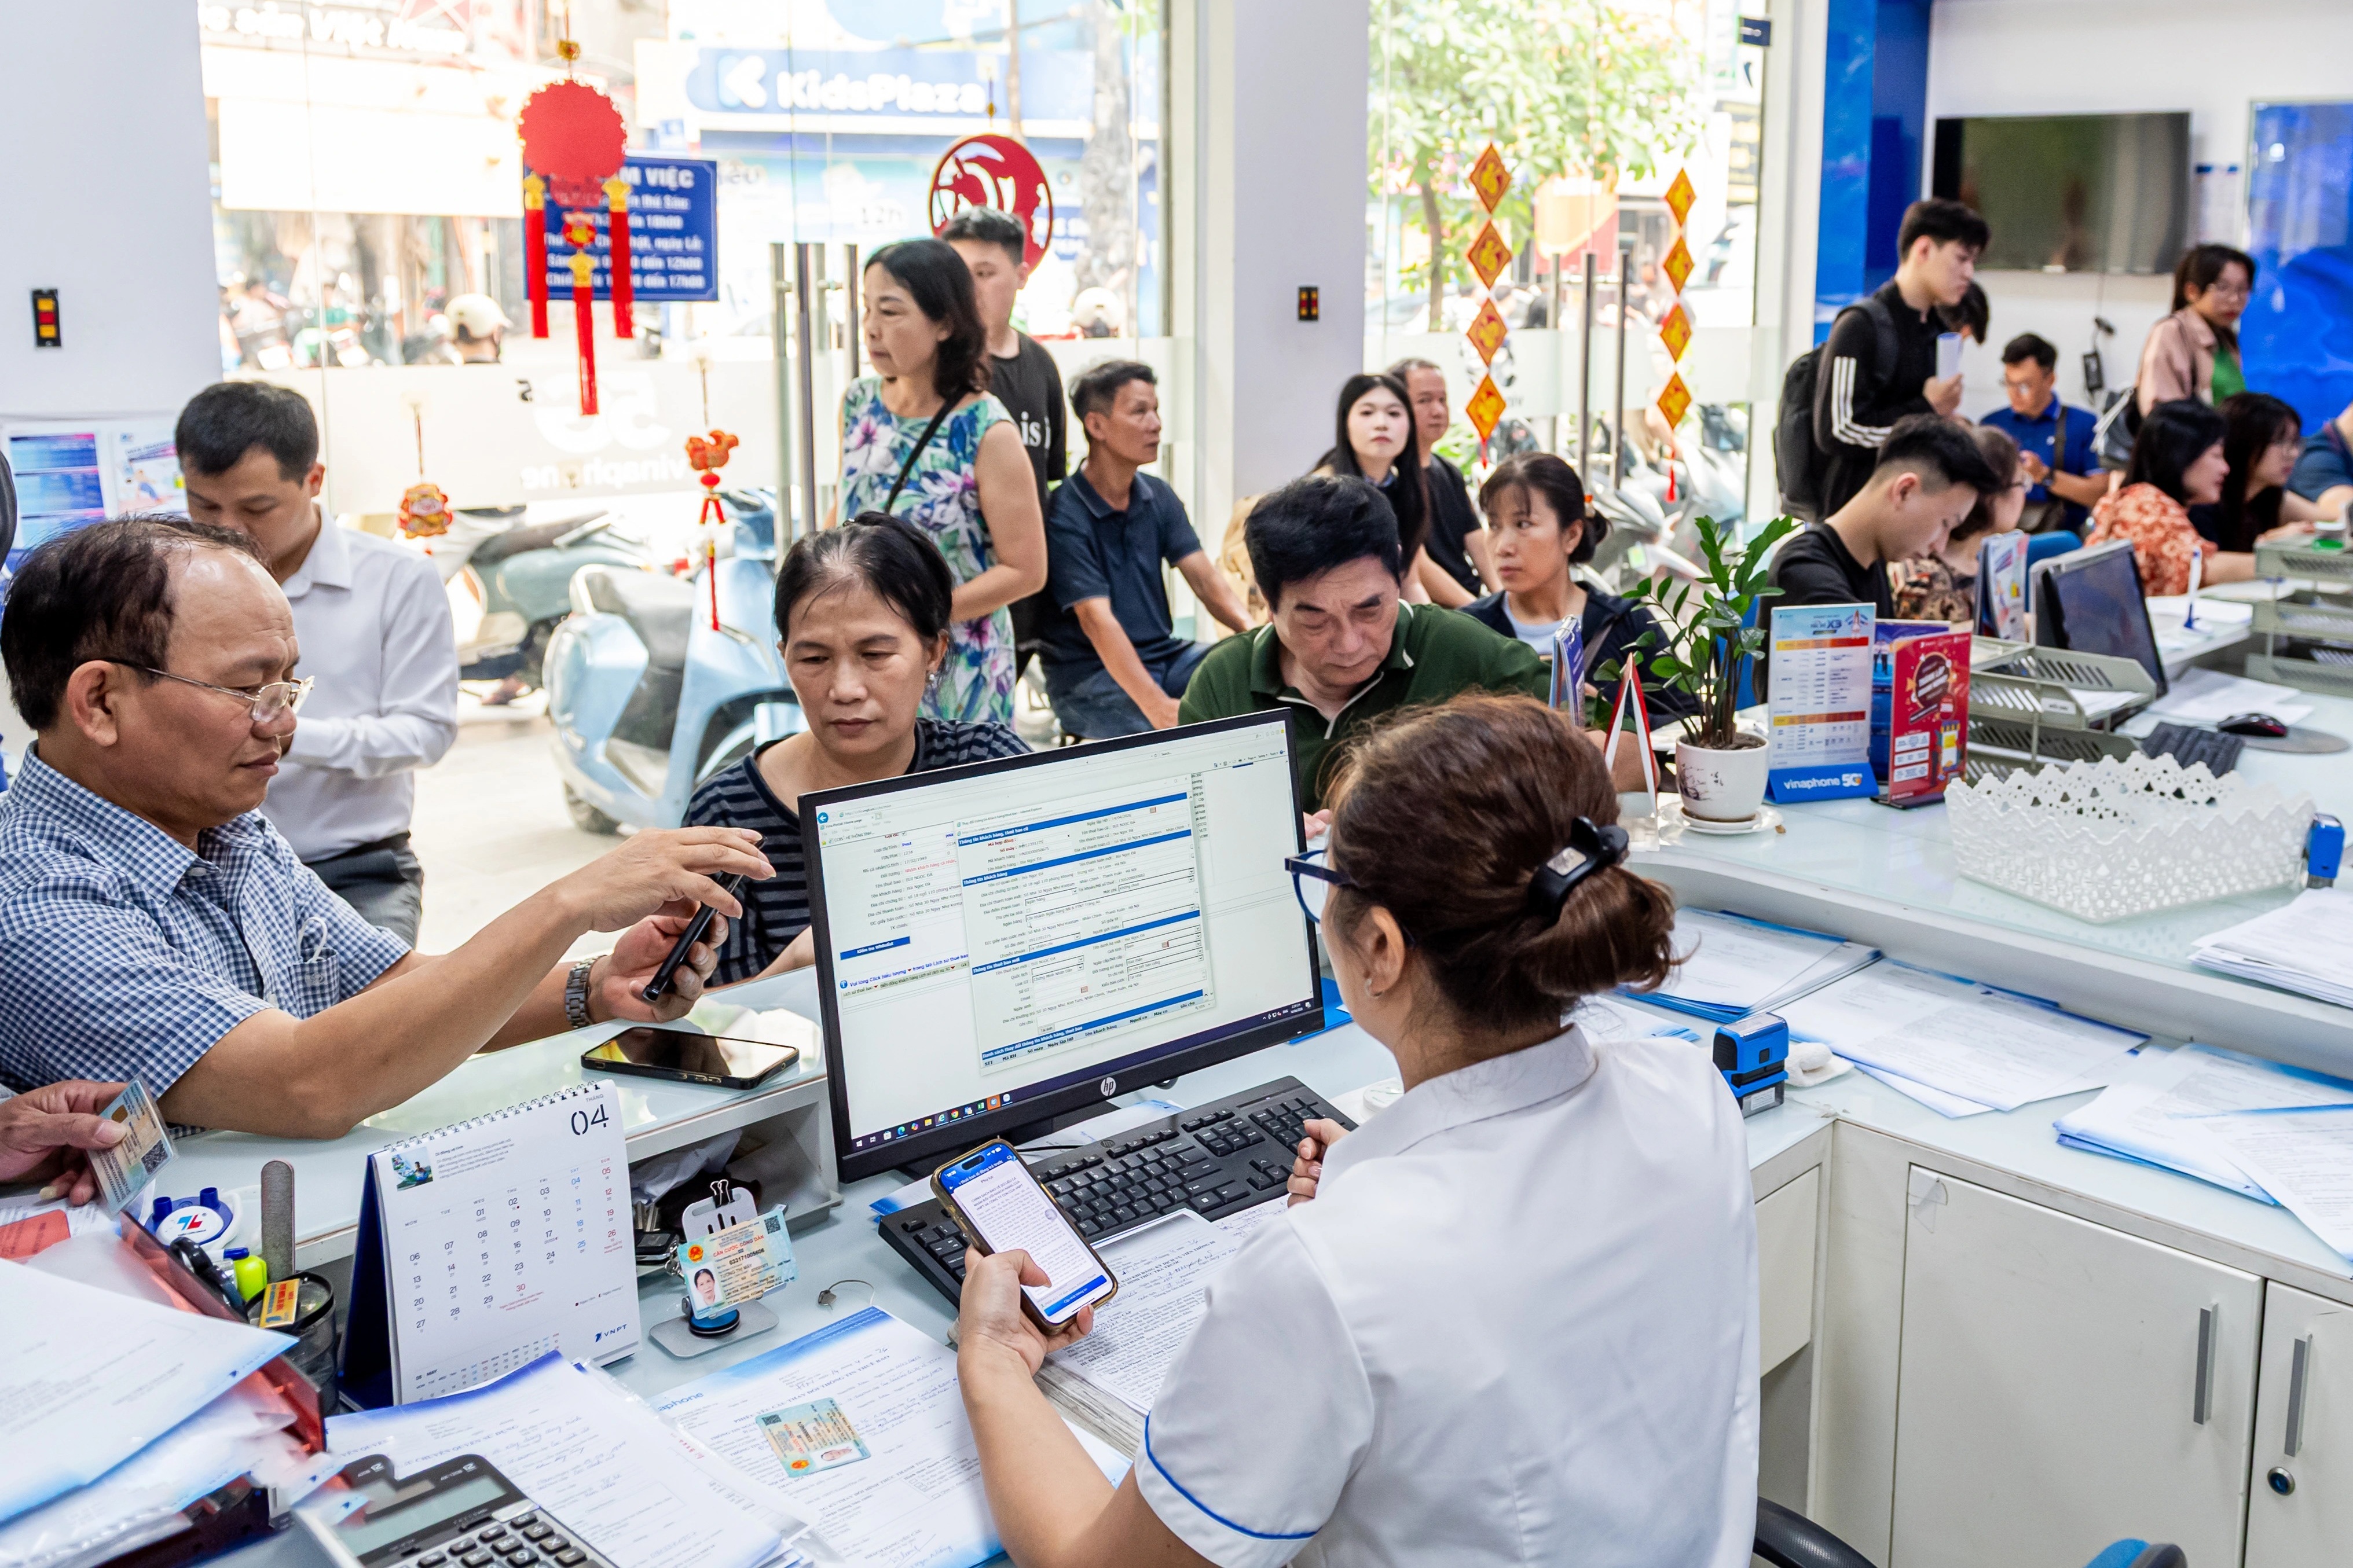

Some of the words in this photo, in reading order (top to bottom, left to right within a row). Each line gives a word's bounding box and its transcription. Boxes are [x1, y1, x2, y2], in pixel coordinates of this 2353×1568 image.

[776, 68, 985, 113] KidsPlaza
[644, 166, 695, 191] VIỆC
[1783, 777, 1840, 789] vinaphone
[1103, 1078, 1113, 1095] hp
[571, 1104, 609, 1135] 04
[476, 1208, 484, 1216] 01
[508, 1197, 518, 1206] 02
[540, 1187, 549, 1195] 03
[571, 1177, 580, 1185] 04
[602, 1166, 611, 1174] 05
[409, 1252, 420, 1261] 06
[444, 1240, 454, 1250] 07
[477, 1230, 488, 1239] 08
[510, 1219, 520, 1227] 09
[447, 1263, 455, 1272] 14
[481, 1251, 488, 1259] 15
[513, 1240, 521, 1248] 16
[545, 1229, 552, 1237] 17
[739, 1238, 753, 1247] CÔNG
[413, 1297, 424, 1306] 20
[449, 1286, 457, 1294] 21
[482, 1273, 491, 1282] 22
[514, 1262, 523, 1270] 23
[546, 1251, 555, 1259] 24
[577, 1239, 586, 1248] 25
[607, 1229, 616, 1237] 26
[416, 1319, 426, 1328] 27
[450, 1307, 460, 1316] 28
[483, 1295, 493, 1304] 29
[516, 1283, 526, 1292] 30
[604, 1324, 627, 1336] VNPT
[658, 1392, 704, 1411] aphone
